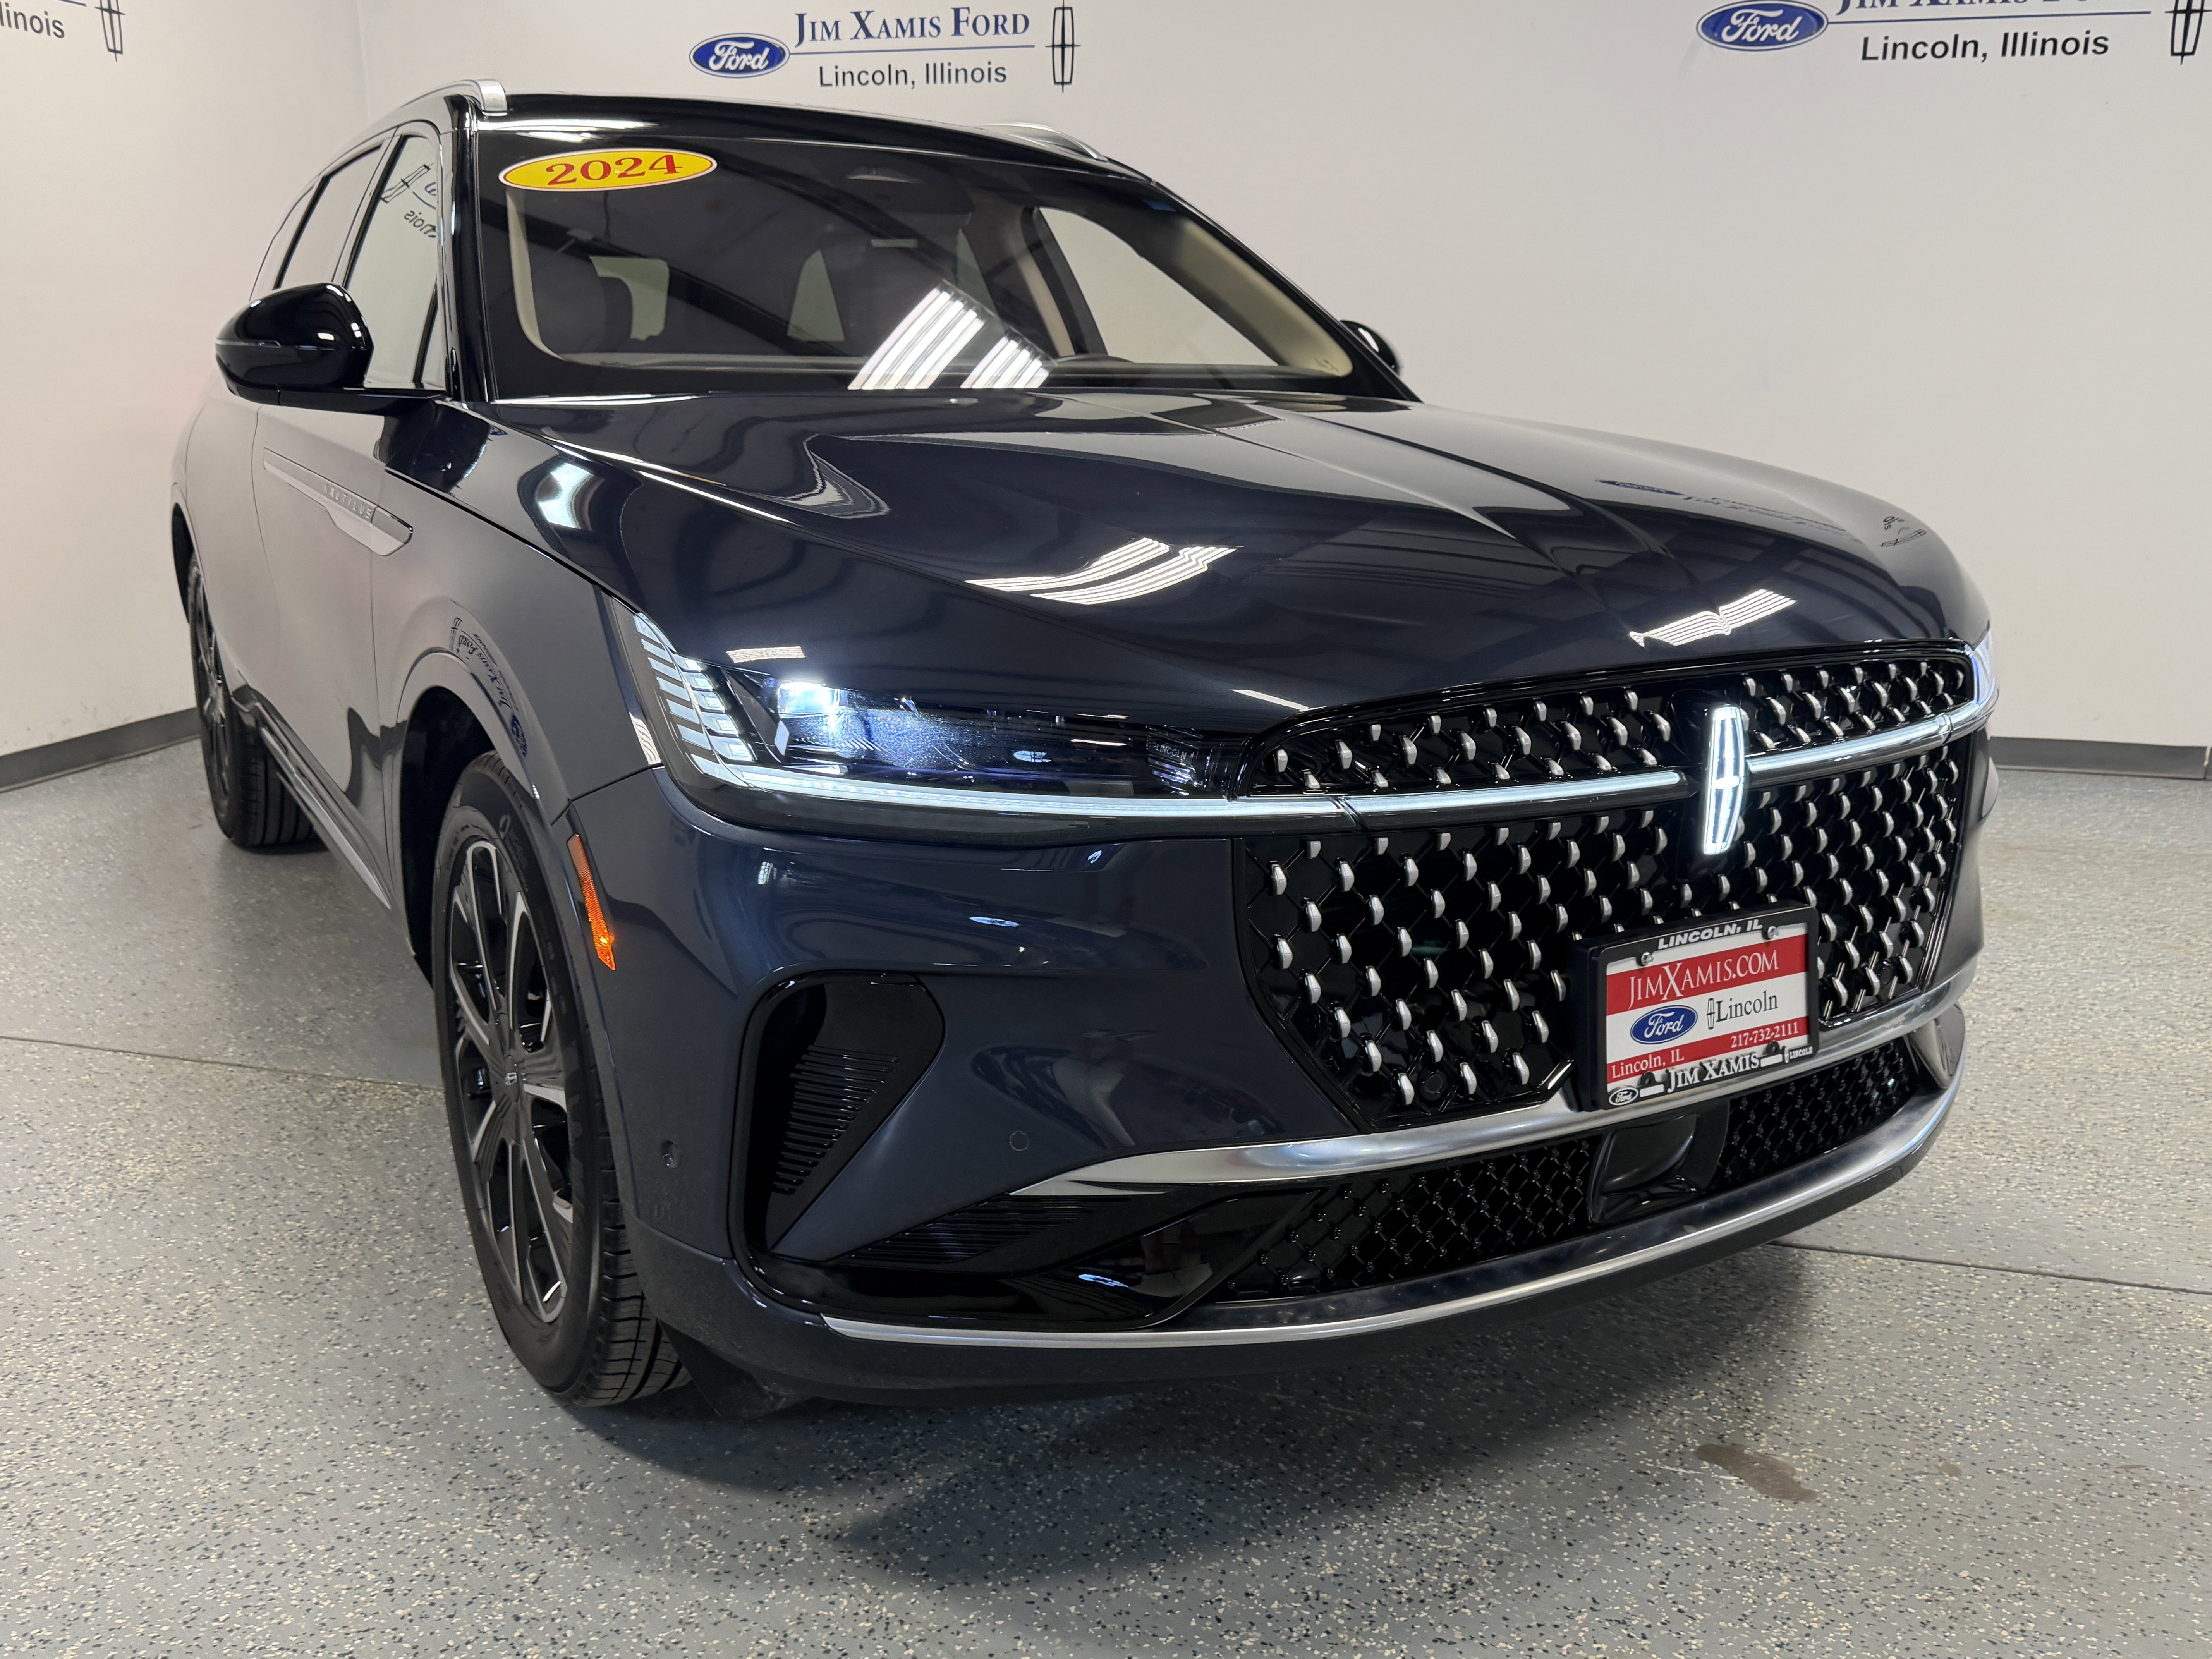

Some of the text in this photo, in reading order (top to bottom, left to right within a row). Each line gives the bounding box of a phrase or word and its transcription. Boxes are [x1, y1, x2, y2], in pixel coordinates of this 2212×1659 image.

[795, 7, 1030, 48] JIM XAMIS FORD
[1721, 9, 1803, 42] Ford
[708, 40, 770, 71] Ford
[1861, 30, 2109, 63] Lincoln, Illinois
[819, 61, 1007, 89] Lincoln, Illinois
[546, 155, 683, 185] 2024
[1155, 743, 1187, 760] LINCOLN
[1658, 919, 1763, 949] LINCOLN, IL
[1628, 950, 1779, 1009] JIMXAMIS.COM
[1716, 990, 1779, 1022] Lincoln
[1644, 1011, 1684, 1038] Ford
[1731, 1021, 1799, 1048] 217-732-2111
[1611, 1049, 1684, 1079] Lincoln, IL
[1667, 1053, 1760, 1093] JIM XAMIS
[1615, 1091, 1632, 1103] Ford
